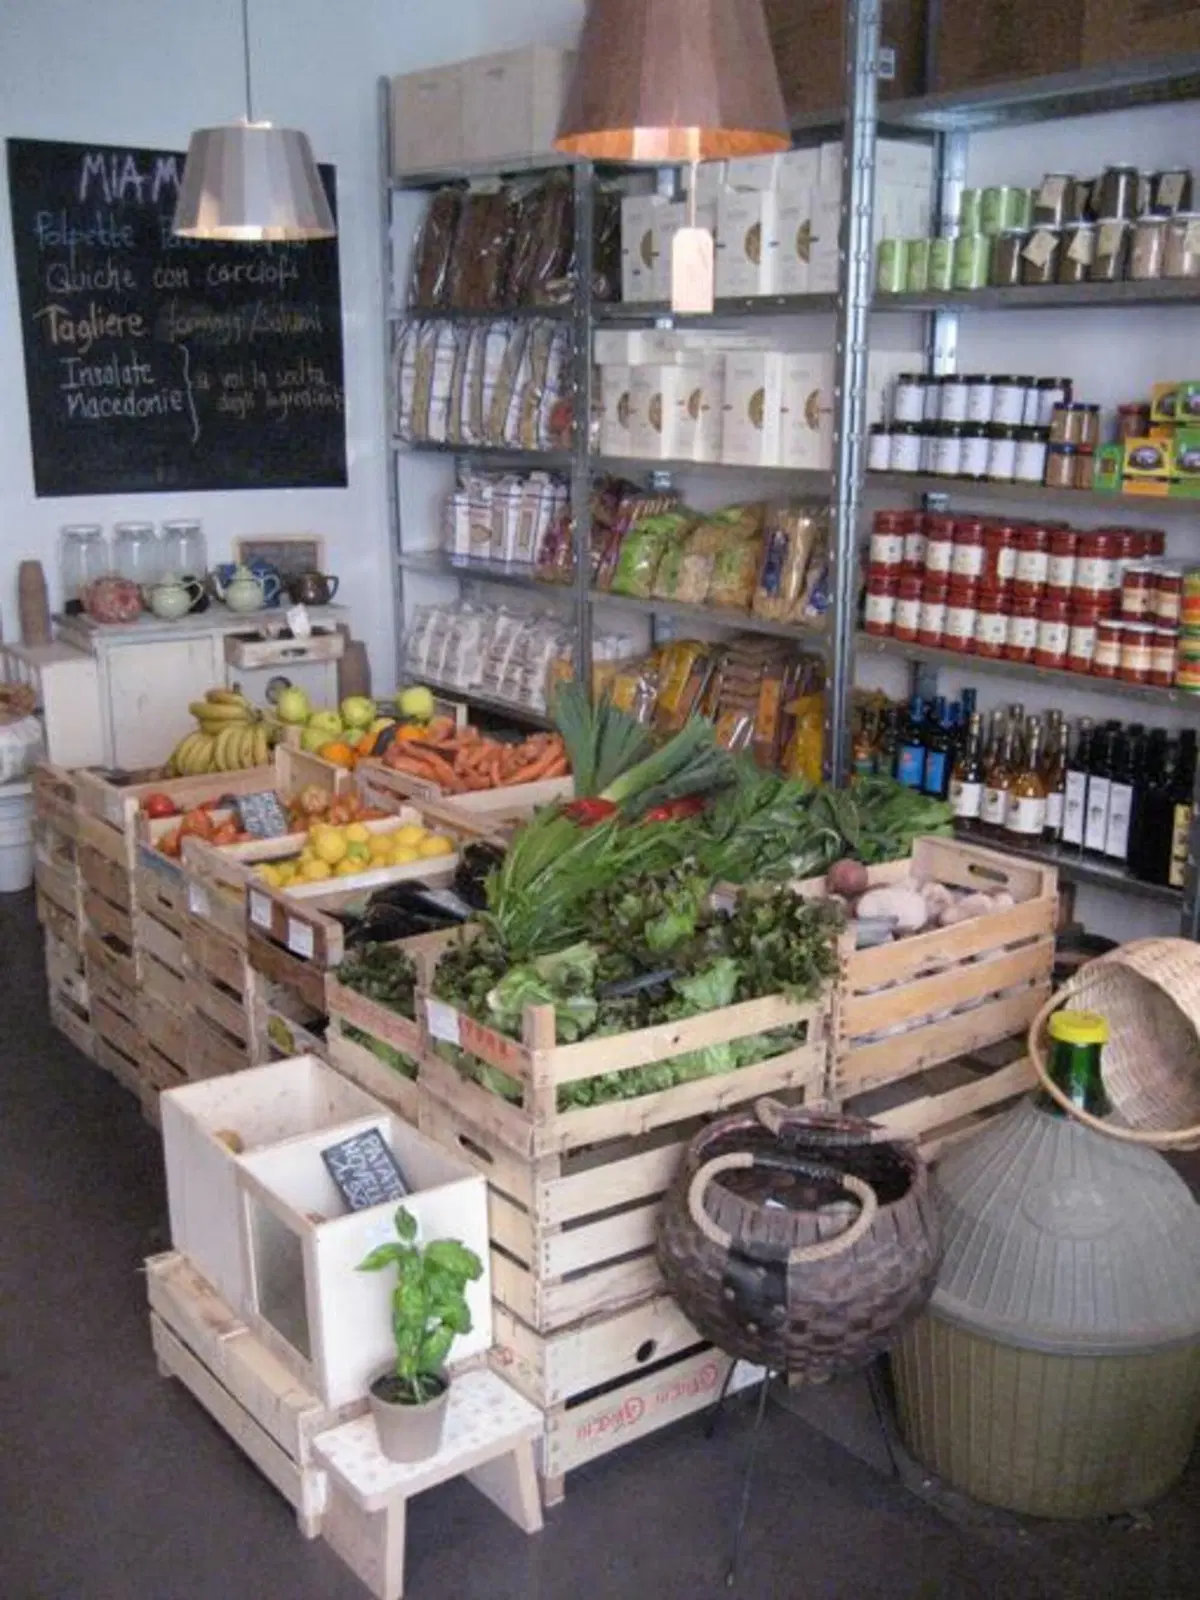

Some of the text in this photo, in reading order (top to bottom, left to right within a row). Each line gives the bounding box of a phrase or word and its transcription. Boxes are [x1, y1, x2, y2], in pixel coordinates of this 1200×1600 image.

[47, 258, 138, 295] Quiche
[153, 265, 190, 290] con
[33, 302, 147, 353] Tagliere
[60, 350, 156, 389] Insalate
